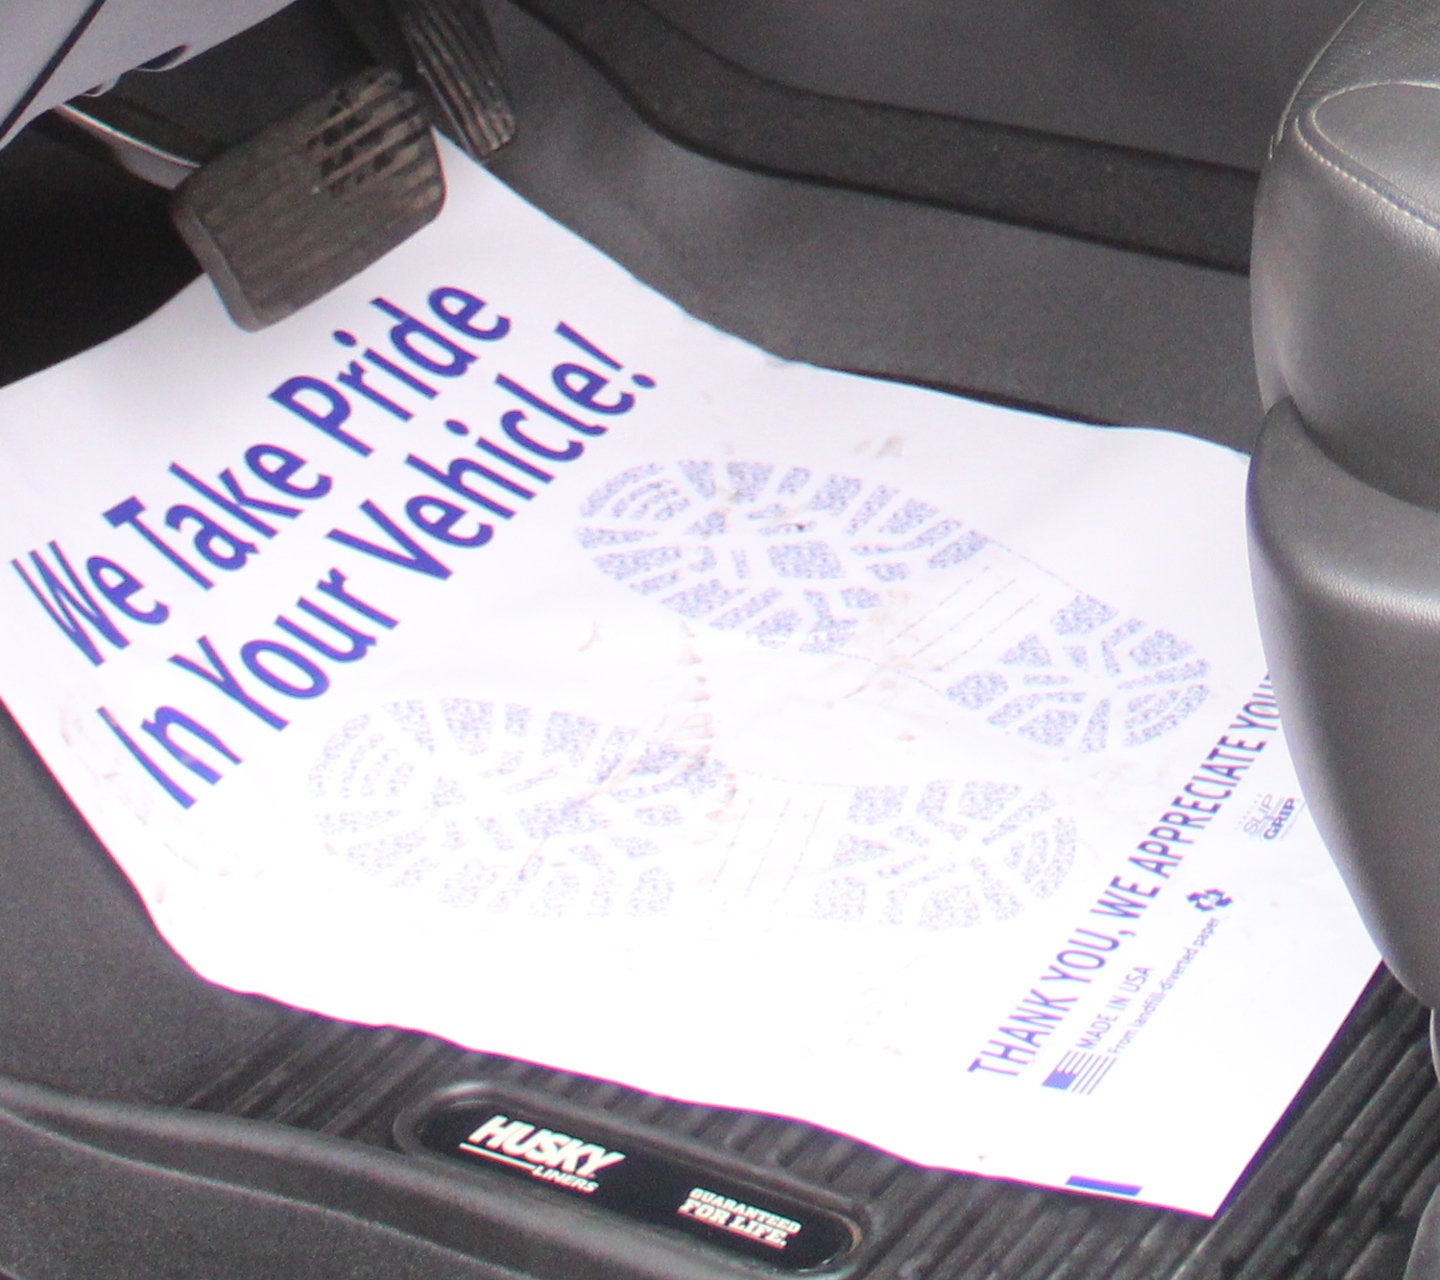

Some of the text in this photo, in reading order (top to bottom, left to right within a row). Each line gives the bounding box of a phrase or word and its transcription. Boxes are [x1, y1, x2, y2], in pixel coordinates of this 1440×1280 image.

[11, 286, 511, 667] We Take Pride
[96, 321, 657, 810] In Your Vehicle!
[1263, 797, 1295, 840] GRIP
[967, 987, 1079, 1077] THANK
[1040, 927, 1137, 984] YOU,
[1089, 875, 1161, 919] WE
[1127, 734, 1267, 879] APPRECIATE
[1074, 966, 1154, 1050] MADE IN USA
[467, 1114, 626, 1177] HUSKY
[531, 1165, 599, 1194] LINERS
[689, 1187, 802, 1235] GUARANTEED
[677, 1198, 728, 1228] FOR
